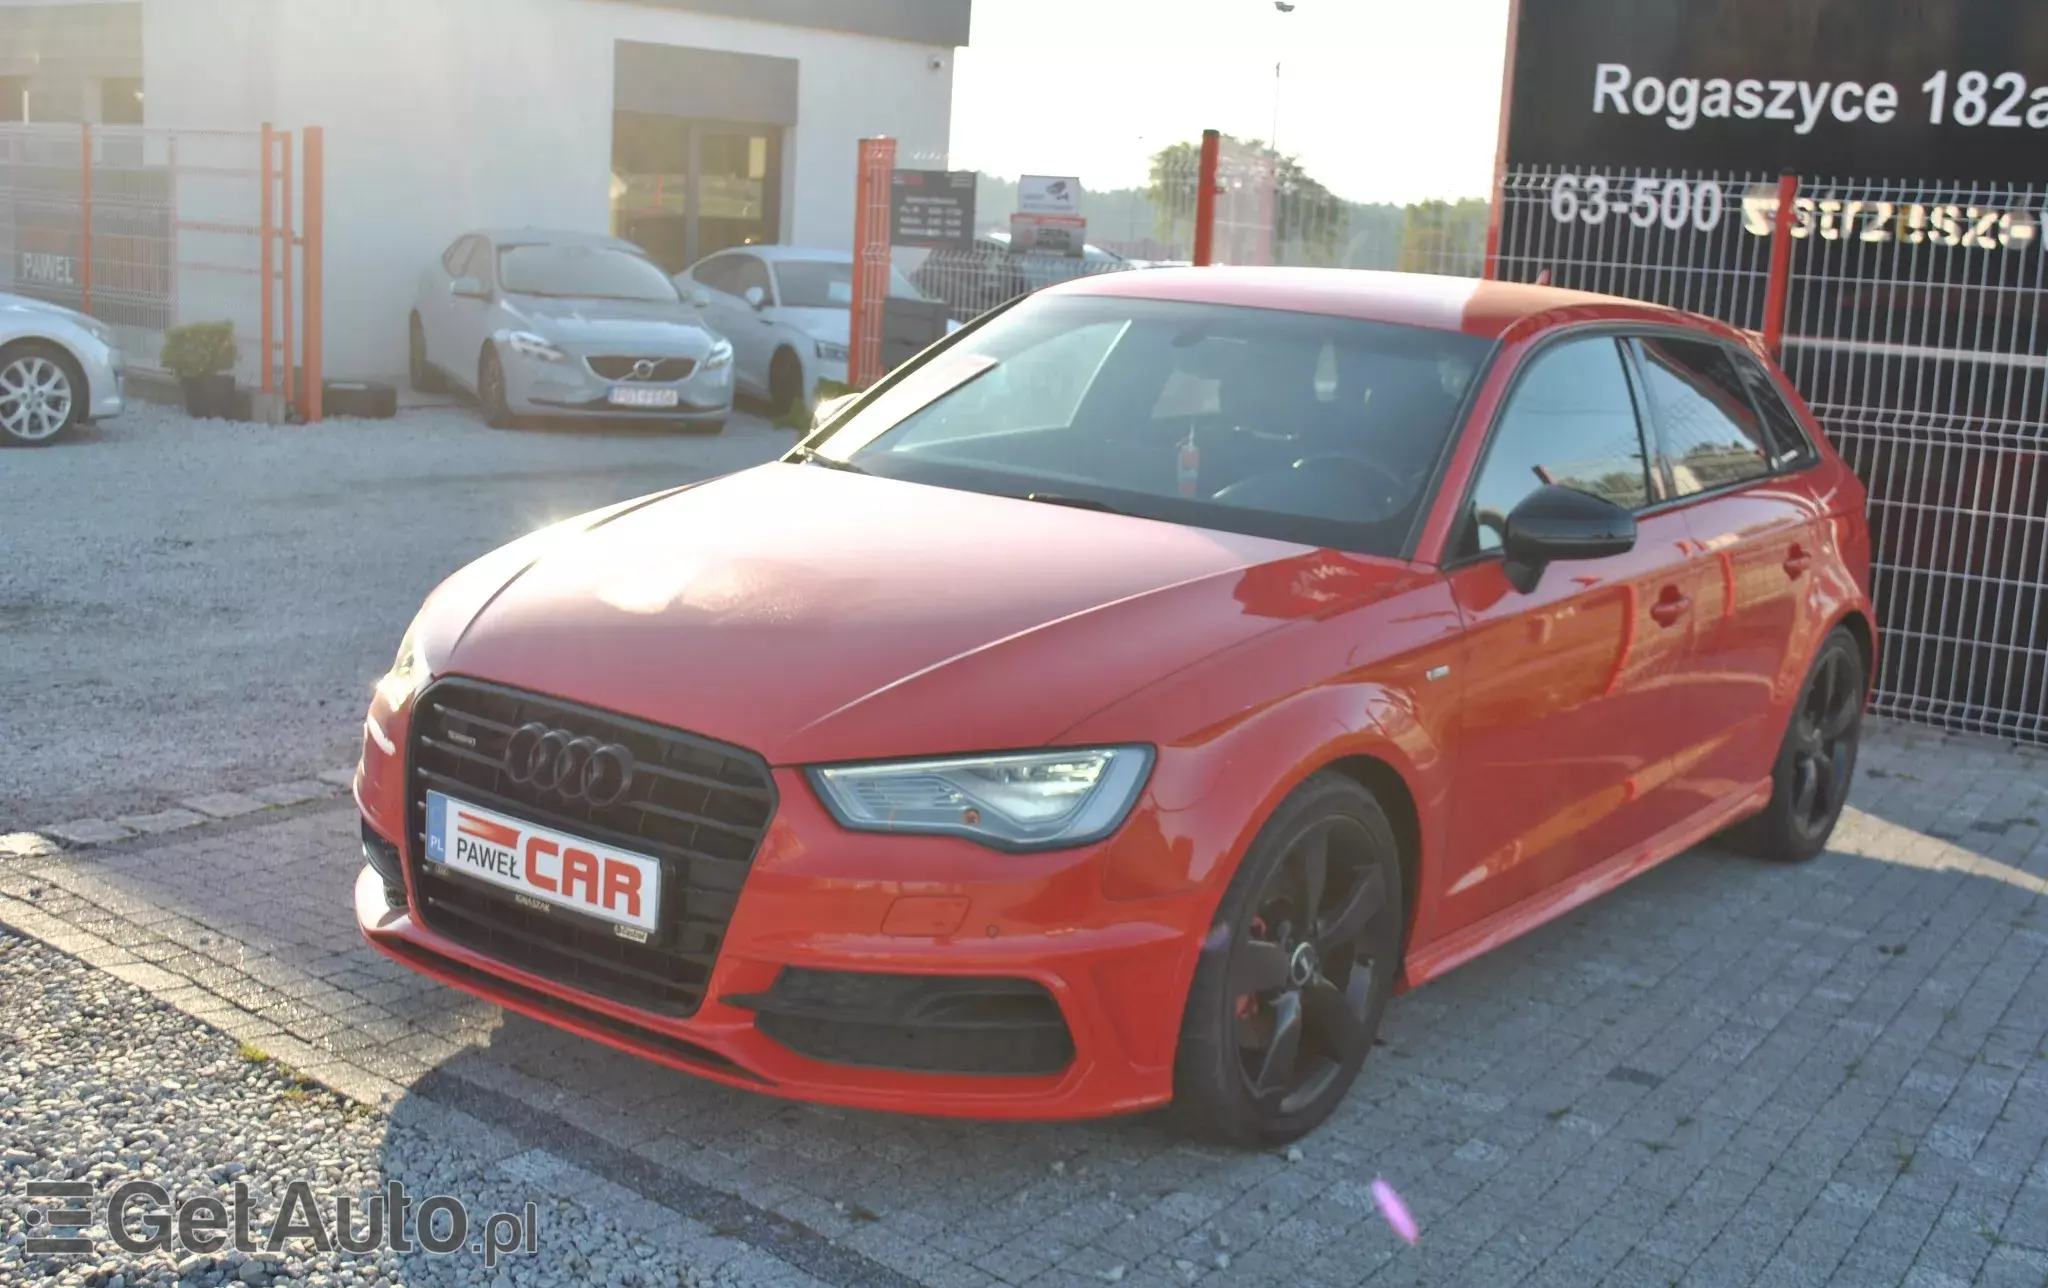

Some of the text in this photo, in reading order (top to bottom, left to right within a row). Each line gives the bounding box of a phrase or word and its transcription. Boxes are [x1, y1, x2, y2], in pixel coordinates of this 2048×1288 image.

[1592, 63, 2048, 134] Rogaszyce 182a
[1550, 173, 1722, 232] 63-500
[430, 835, 444, 851] PL
[456, 836, 643, 917] PAWEŁ CAR
